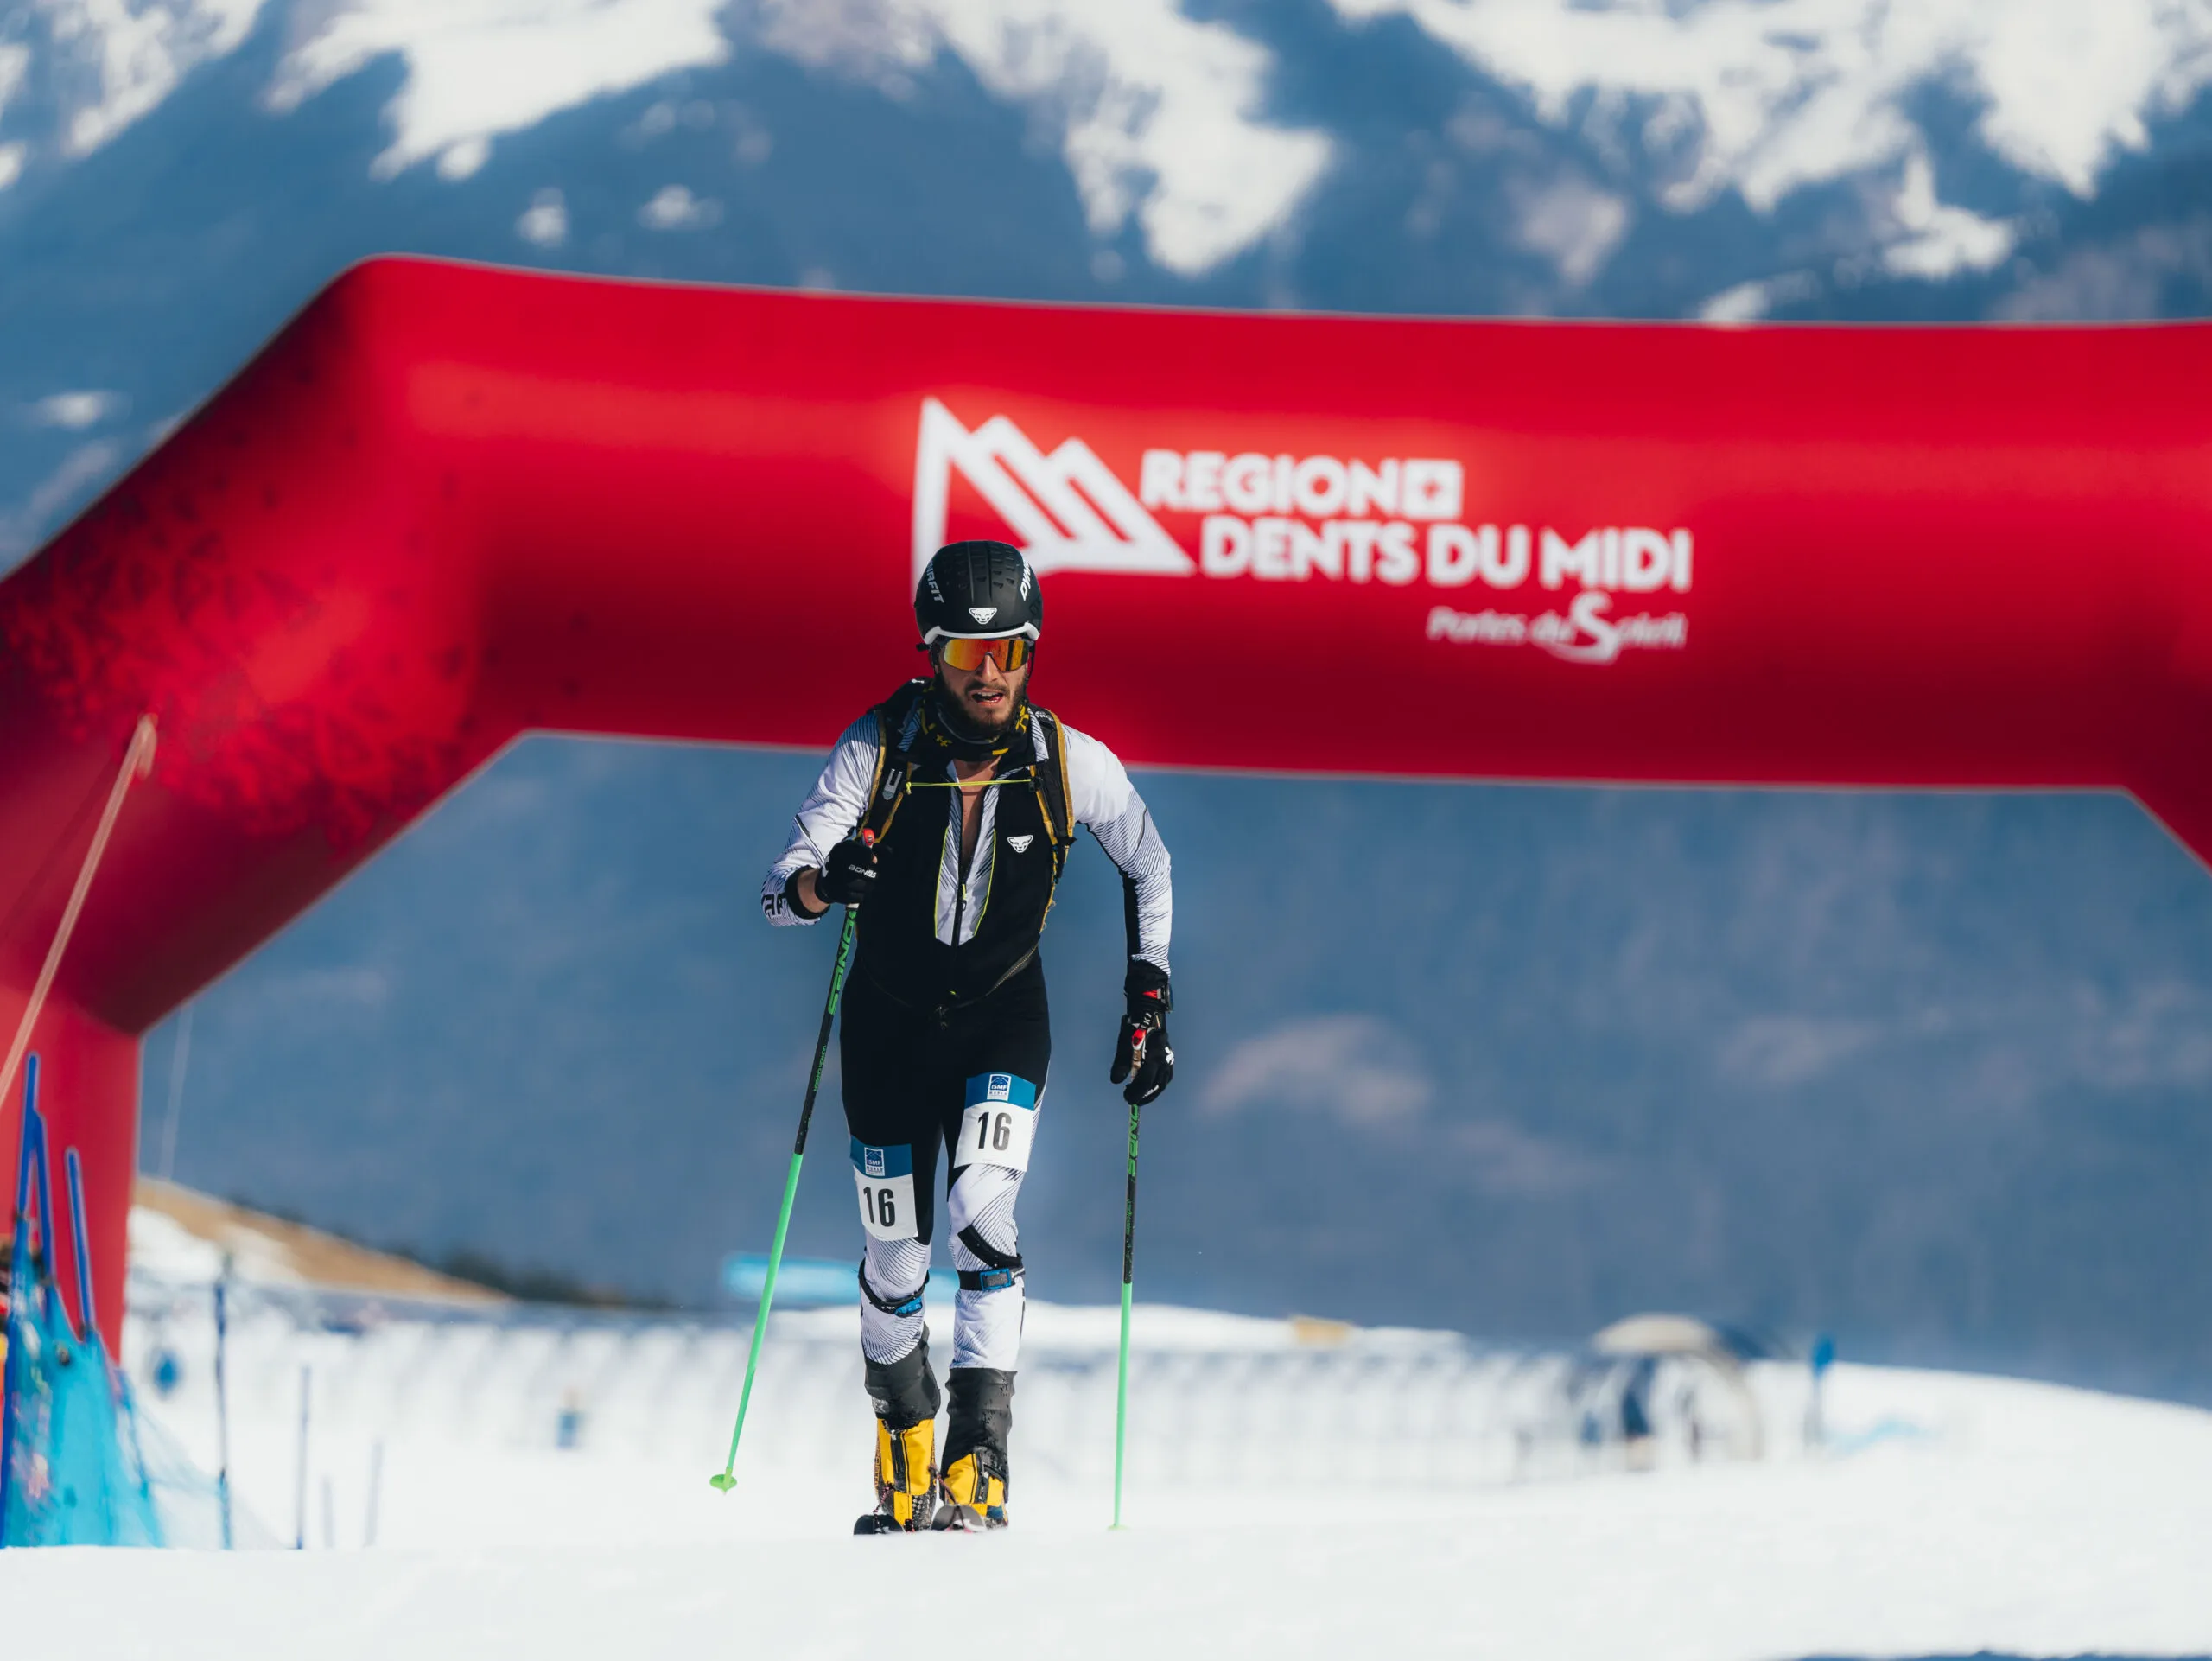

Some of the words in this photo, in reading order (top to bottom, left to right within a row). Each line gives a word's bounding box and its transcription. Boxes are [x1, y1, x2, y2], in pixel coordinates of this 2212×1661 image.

[1141, 449, 1402, 519] REGION
[1201, 514, 1422, 585] DENTS
[1427, 523, 1532, 589] DU
[1540, 525, 1694, 593] MIDI
[827, 909, 858, 1016] ONES
[977, 1111, 1012, 1151] 16
[863, 1186, 895, 1227] 16
